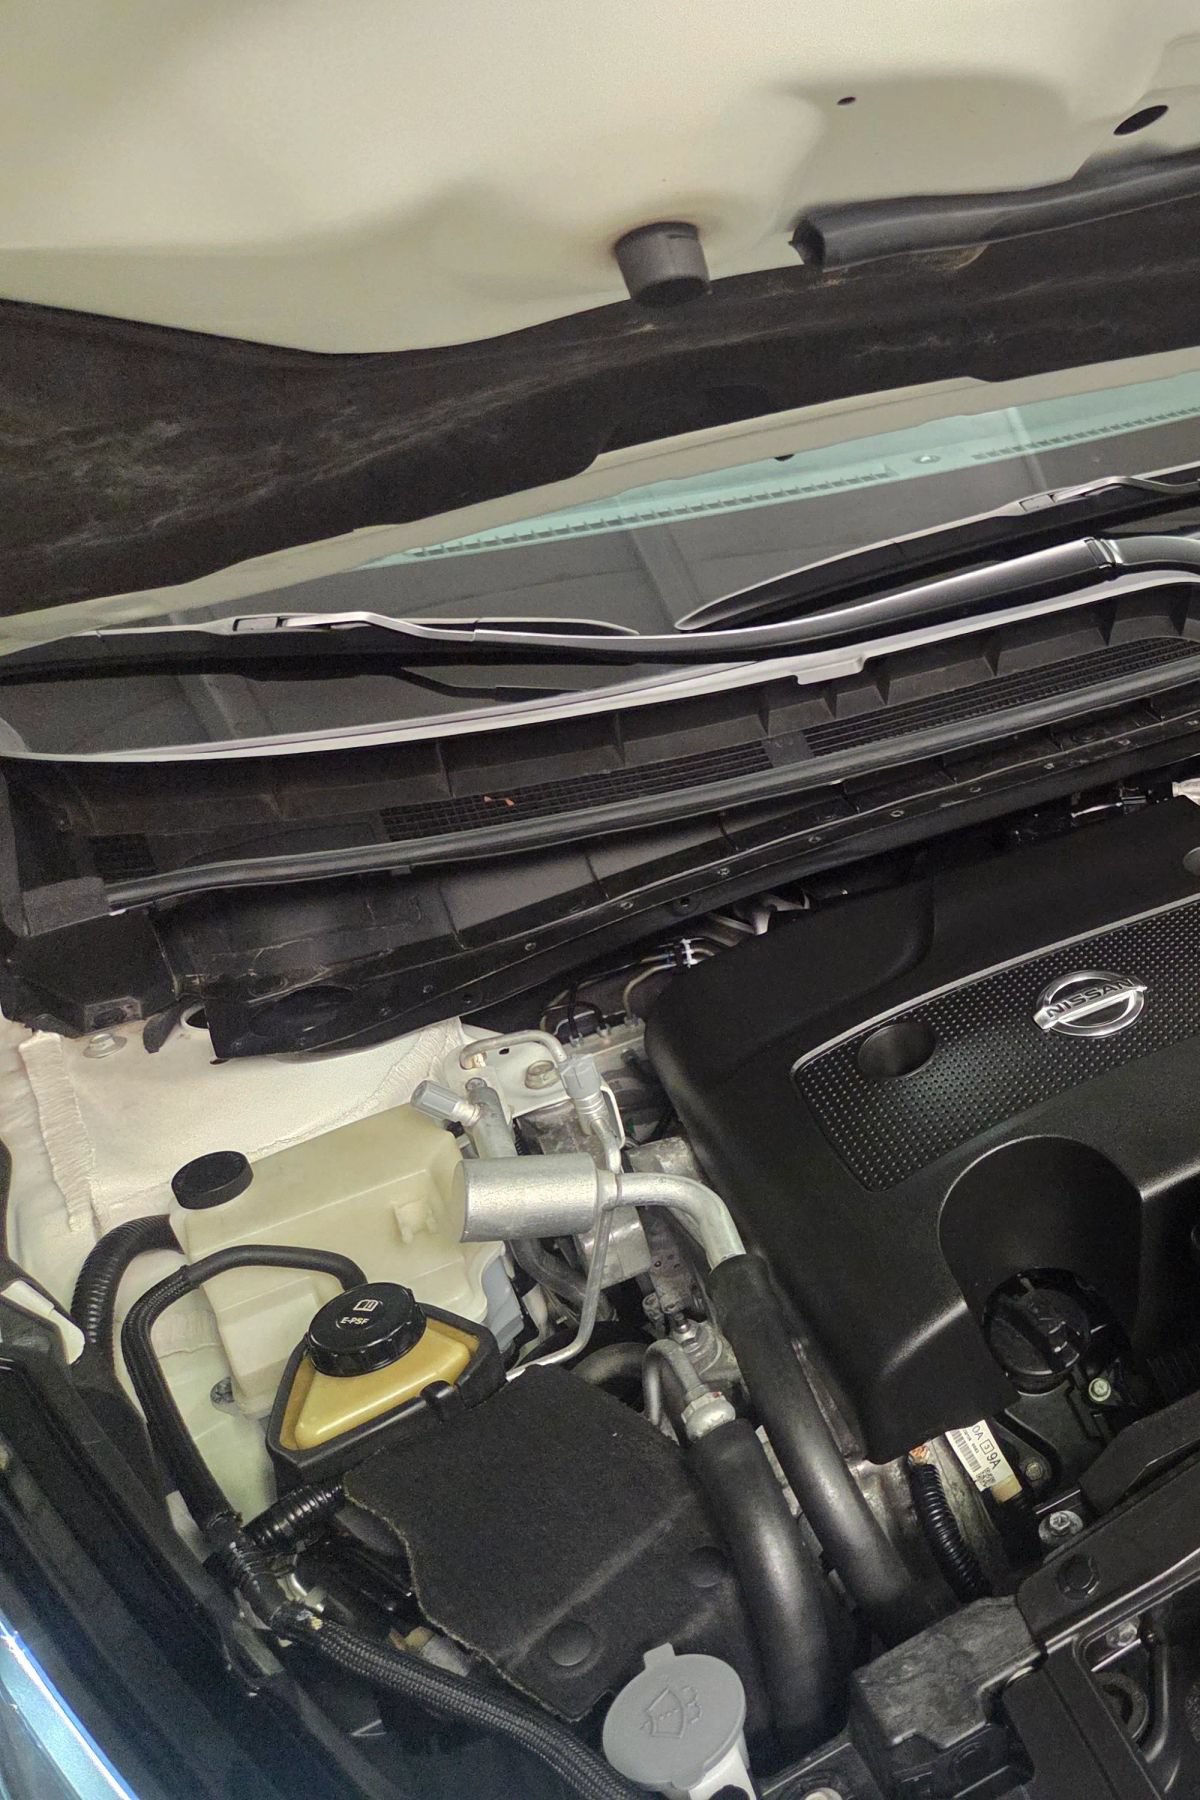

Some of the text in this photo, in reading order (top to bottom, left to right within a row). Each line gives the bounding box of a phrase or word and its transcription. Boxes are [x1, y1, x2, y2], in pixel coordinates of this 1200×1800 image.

[1046, 979, 1135, 1018] NISSAN
[340, 1316, 370, 1325] E-PSF
[986, 1451, 1001, 1470] 9A
